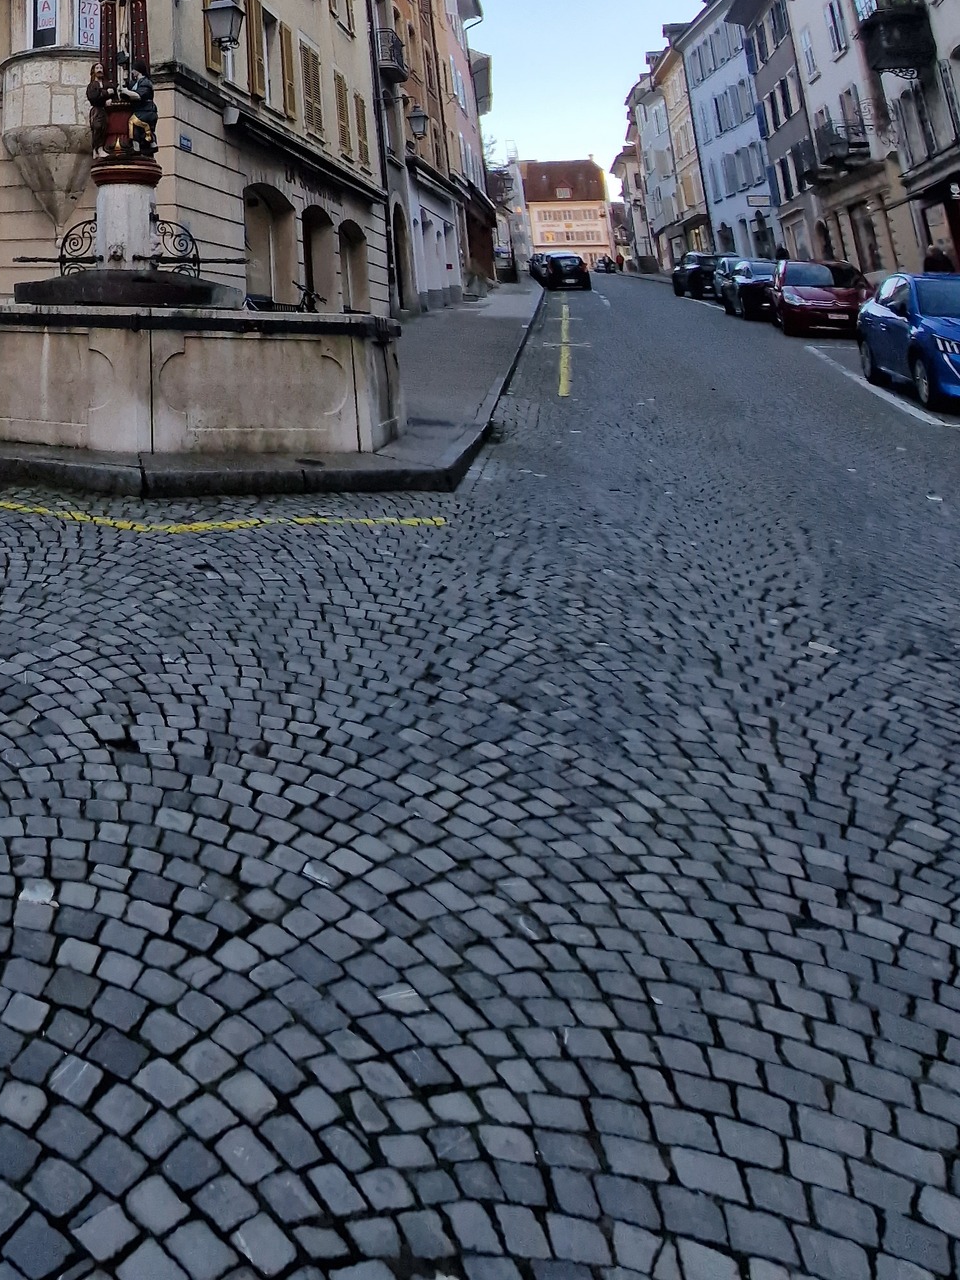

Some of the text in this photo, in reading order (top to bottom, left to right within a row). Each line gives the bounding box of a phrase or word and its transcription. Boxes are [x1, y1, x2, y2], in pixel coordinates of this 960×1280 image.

[42, 0, 51, 12] A
[81, 1, 99, 16] 272
[83, 17, 95, 30] 18
[82, 31, 95, 45] 94
